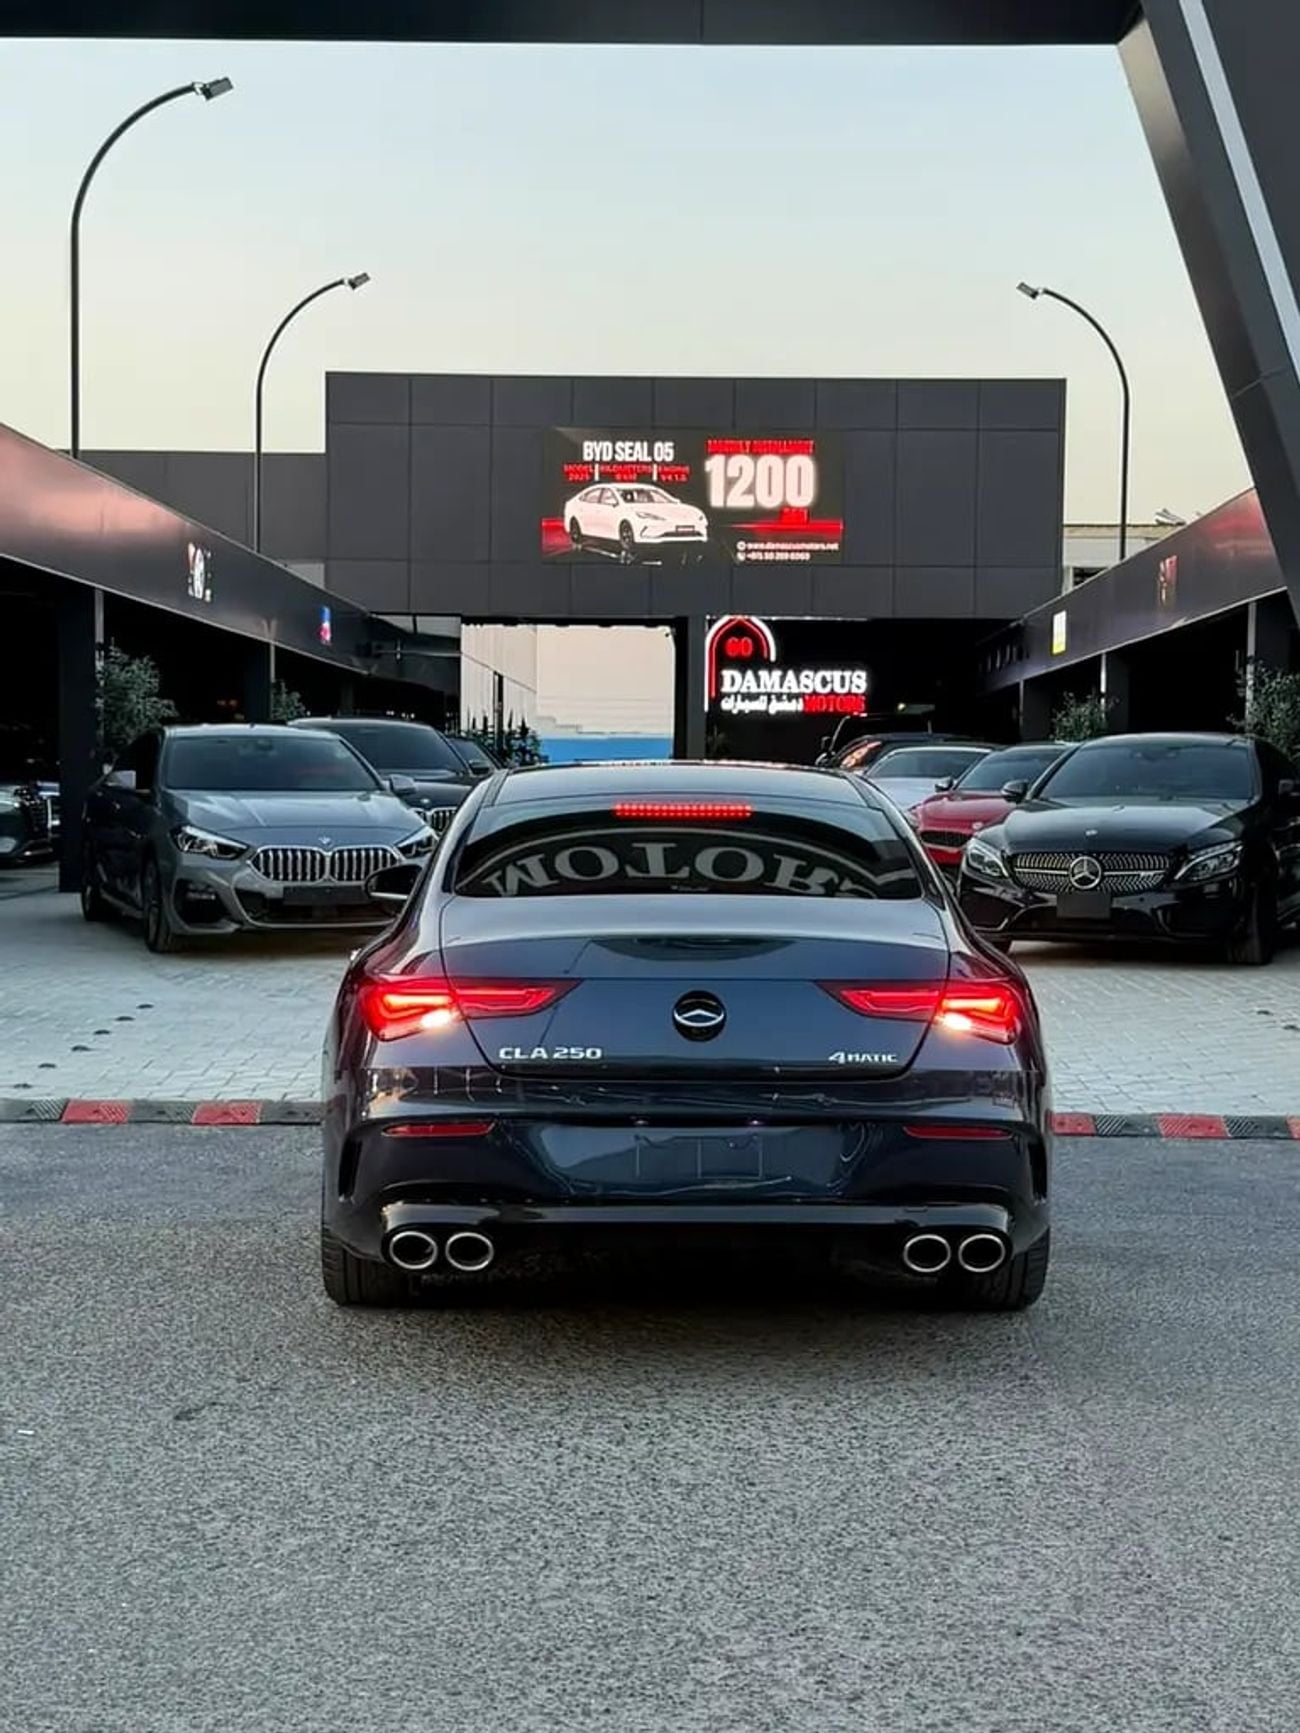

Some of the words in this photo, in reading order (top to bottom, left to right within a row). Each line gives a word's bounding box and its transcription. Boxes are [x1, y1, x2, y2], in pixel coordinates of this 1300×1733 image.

[583, 441, 613, 462] BYD
[614, 441, 652, 462] SEAL
[653, 441, 675, 462] 05
[704, 455, 816, 509] 1200
[720, 669, 868, 694] DAMASCUS
[804, 694, 866, 713] MOTORS
[499, 1047, 548, 1060] CLA
[552, 1047, 603, 1060] 250
[827, 1051, 898, 1064] 4MATIC
